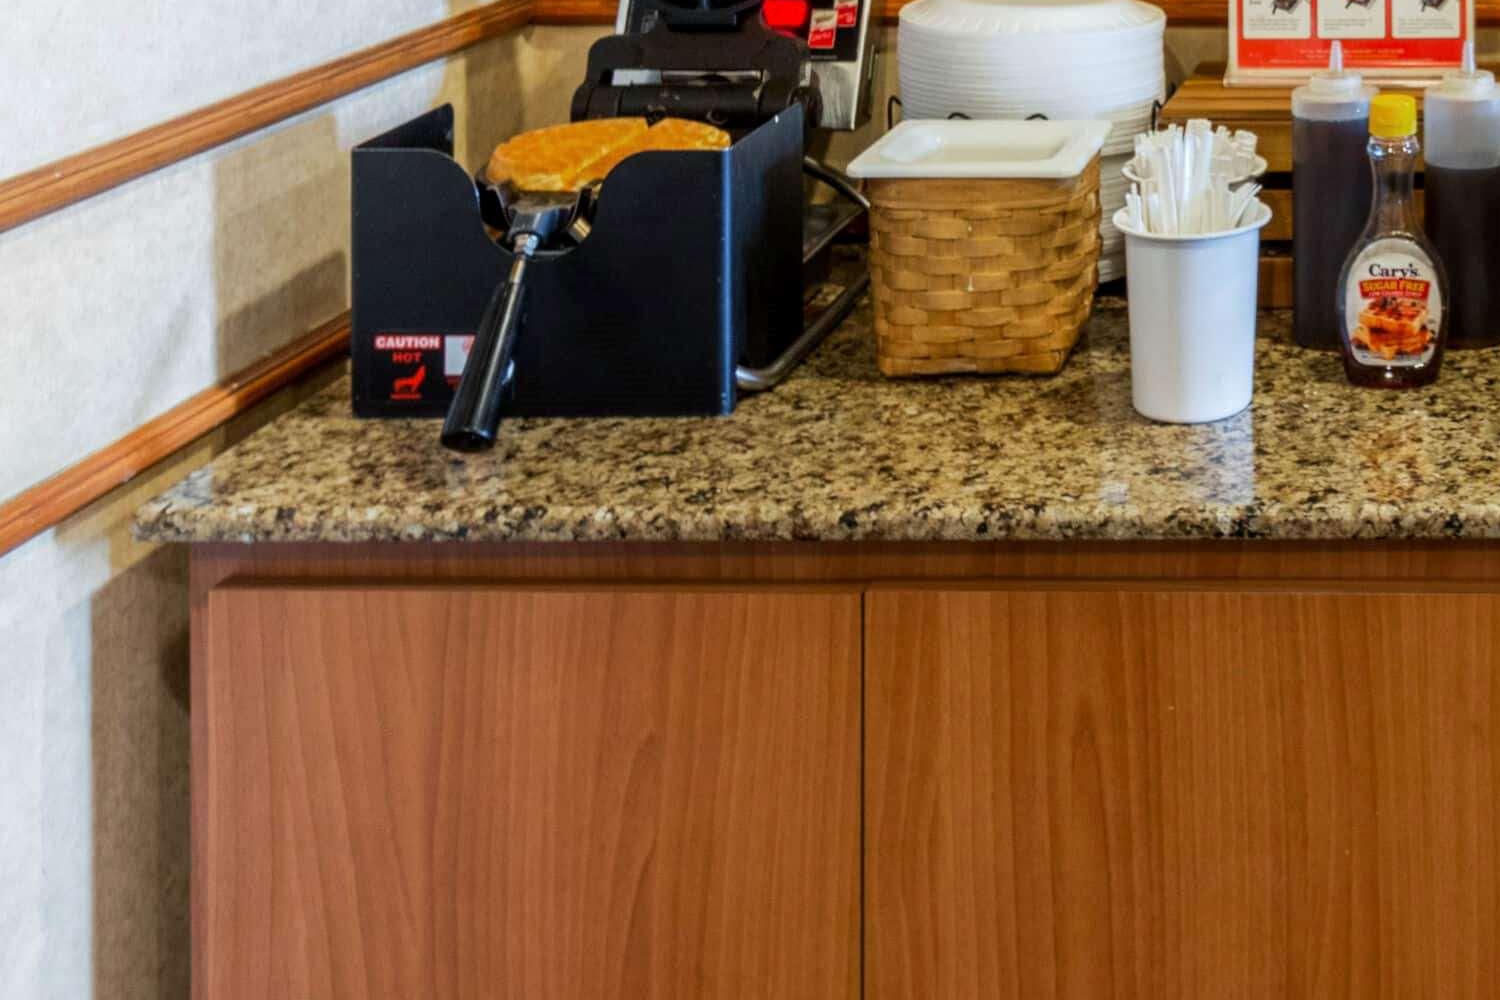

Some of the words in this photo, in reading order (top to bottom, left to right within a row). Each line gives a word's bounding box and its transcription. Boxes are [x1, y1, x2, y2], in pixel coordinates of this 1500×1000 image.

[1368, 263, 1419, 280] Cary's
[1363, 280, 1397, 292] SUGAR
[1399, 280, 1425, 292] FREE
[375, 336, 440, 349] CAUTION
[393, 352, 422, 363] HOT
